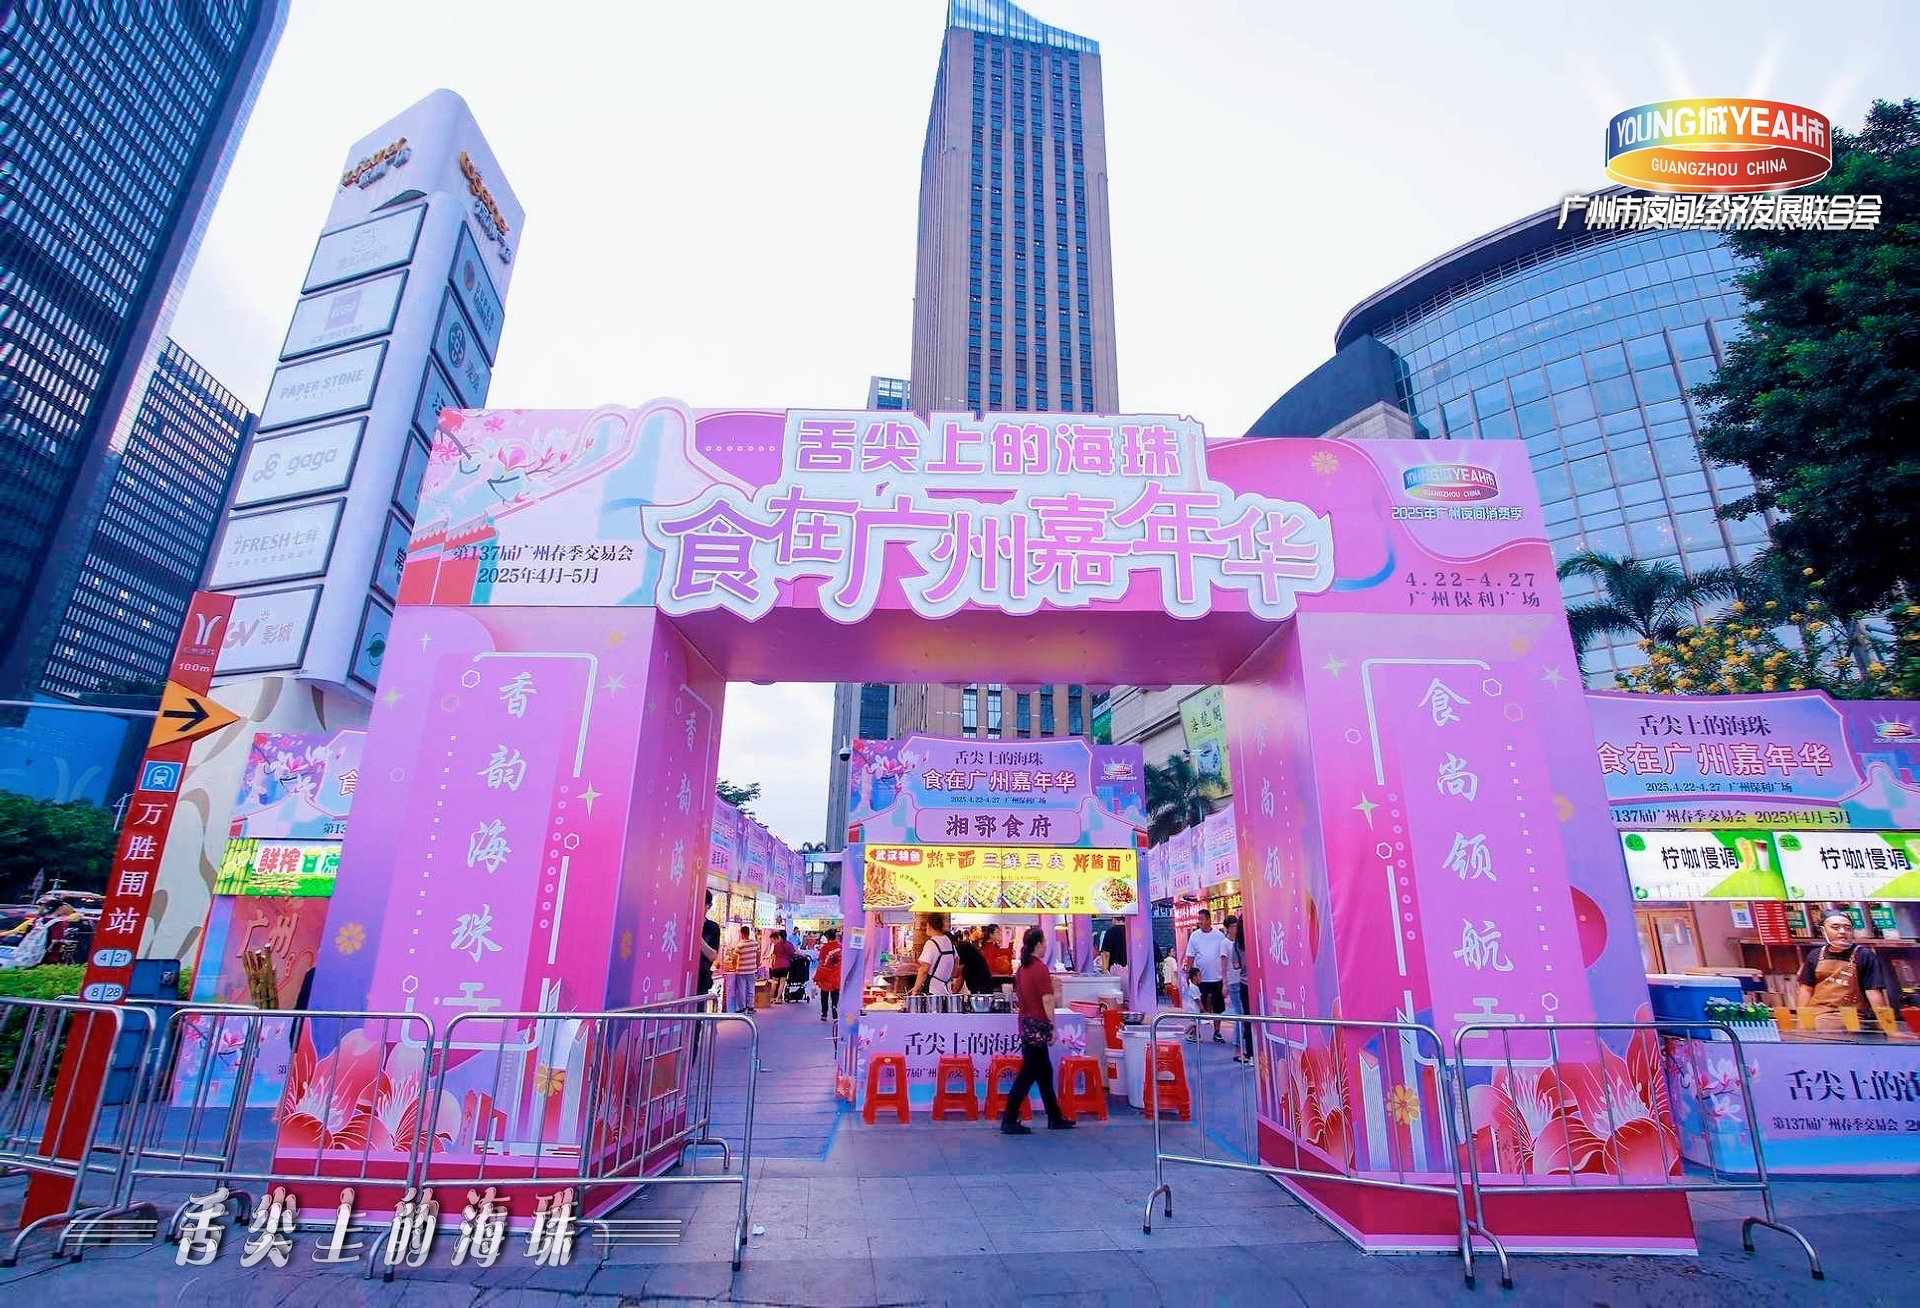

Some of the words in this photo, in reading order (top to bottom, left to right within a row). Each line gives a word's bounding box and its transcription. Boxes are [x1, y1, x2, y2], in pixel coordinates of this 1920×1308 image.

[280, 379, 321, 399] PAPER
[322, 368, 365, 390] STONE
[797, 420, 1182, 477] 舌尖上的海珠
[285, 448, 339, 477] gaga
[1463, 488, 1482, 498] CHINA
[453, 545, 635, 561] 第137届广州春季交易会
[658, 480, 1320, 605] 食在广州嘉年华
[477, 567, 599, 584] 2025年4月-5月
[1405, 572, 1536, 588] 4.22-4.27
[1408, 591, 1541, 607] 广州保利广场
[1638, 714, 1772, 737] 舌尖上的海珠
[954, 749, 1044, 767] 舌尖上的海珠
[1597, 742, 1832, 776] 食在广州嘉年华
[921, 769, 1077, 794] 食在广州嘉年华
[1728, 782, 1793, 793] 广州保利广场
[450, 671, 538, 964] 香韵海珠
[945, 813, 1053, 839] 湘鄂食府
[1416, 676, 1516, 973] 食尚领航
[1610, 809, 1747, 825] 137届广州春季交易会
[1755, 810, 1852, 825] 2025年4月-5月
[875, 849, 921, 862] 武汉特色
[1660, 846, 1740, 870] 柠咖慢调
[1819, 846, 1913, 871] 柠咖慢调
[105, 802, 169, 935] 万胜围站
[99, 952, 108, 963] 4
[114, 952, 128, 963] 21
[91, 987, 100, 998] 8
[105, 986, 122, 998] 28
[1772, 1117, 1899, 1131] 第137届广州春季交易会
